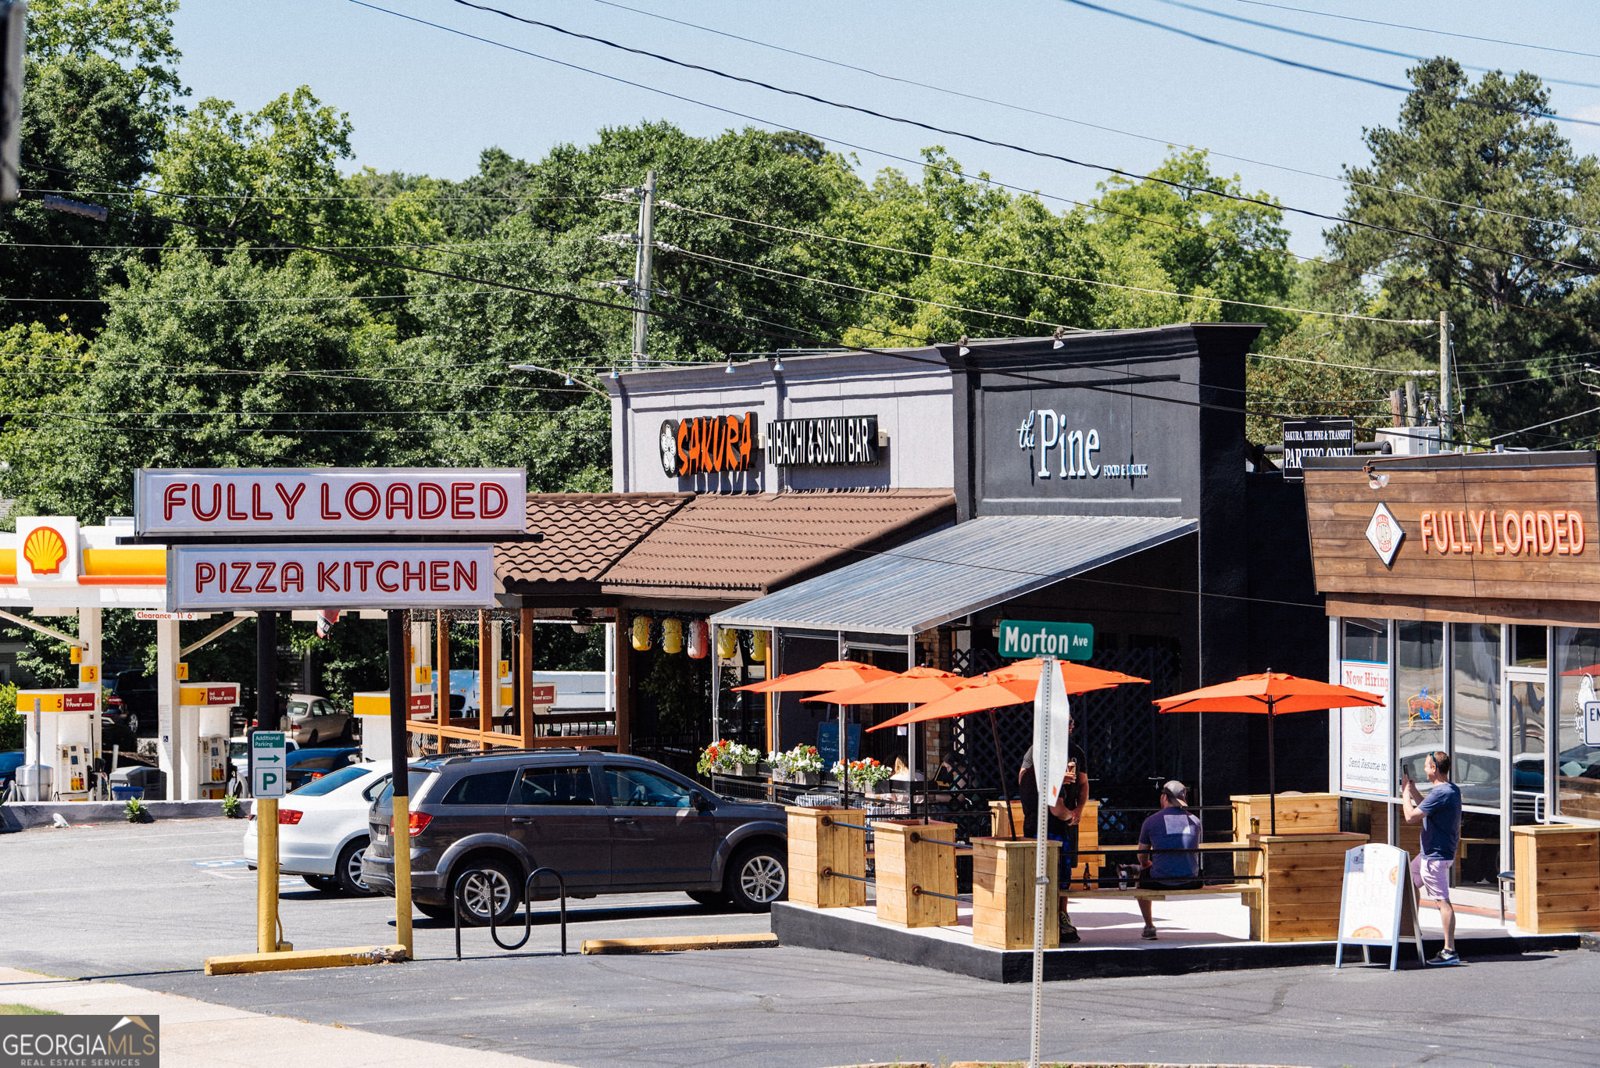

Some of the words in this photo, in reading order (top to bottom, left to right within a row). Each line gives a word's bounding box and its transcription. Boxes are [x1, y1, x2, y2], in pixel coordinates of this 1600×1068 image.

[677, 411, 752, 476] SAKURA
[767, 419, 806, 465] HIBACHI
[808, 420, 815, 464] &
[816, 419, 847, 464] SUSHI
[848, 417, 870, 462] BAR
[1016, 409, 1036, 449] the
[1037, 408, 1101, 478] Pine
[163, 482, 306, 521] FULLY
[321, 481, 509, 520] LOADED
[1420, 510, 1486, 553] FULLY
[1490, 510, 1585, 554] LOADED
[195, 561, 304, 594] PIZZA
[317, 560, 478, 593] KITCHEN
[1005, 626, 1069, 654] Morton
[1072, 635, 1088, 647] Ave
[200, 692, 206, 701] 7
[1346, 671, 1363, 685] Now
[1364, 672, 1389, 692] Hiring
[57, 699, 62, 708] 5
[263, 773, 277, 790] P
